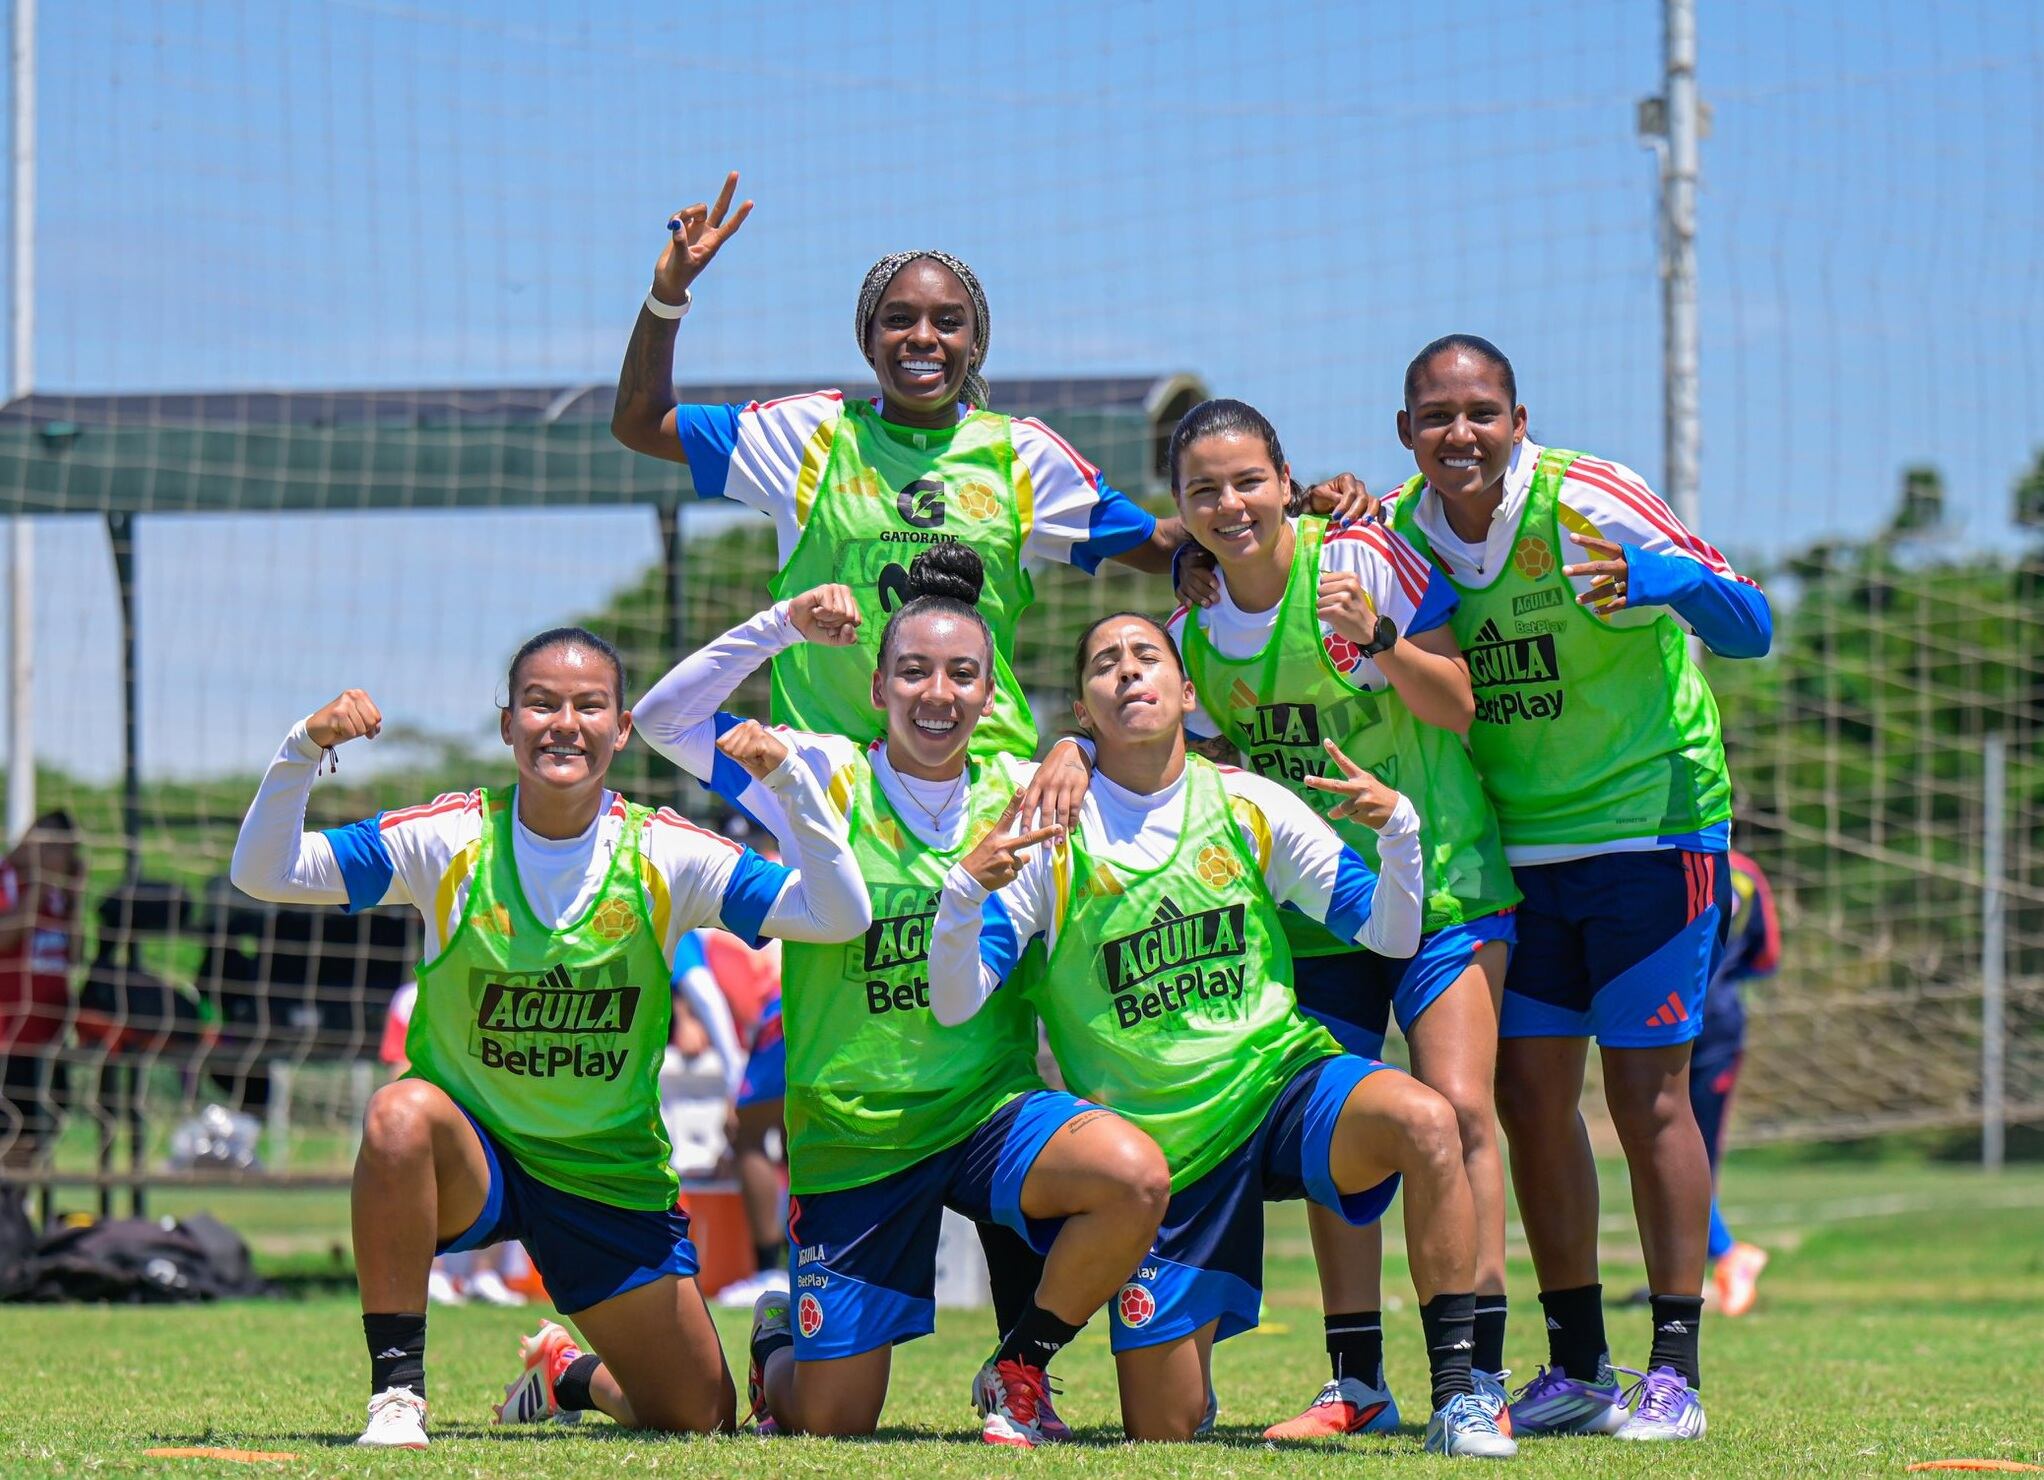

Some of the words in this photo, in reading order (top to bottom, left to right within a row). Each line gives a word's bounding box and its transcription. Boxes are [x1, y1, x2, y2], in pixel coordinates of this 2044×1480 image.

[1515, 589, 1559, 615] AGUILA
[1515, 620, 1568, 634] BetPlay
[1469, 640, 1552, 684] GUILA
[1251, 749, 1326, 790] Play
[1118, 911, 1239, 987] AGUILA
[485, 990, 622, 1030] AGUILA
[1114, 963, 1246, 1029] BetPlay
[482, 1037, 629, 1081] BetPlay
